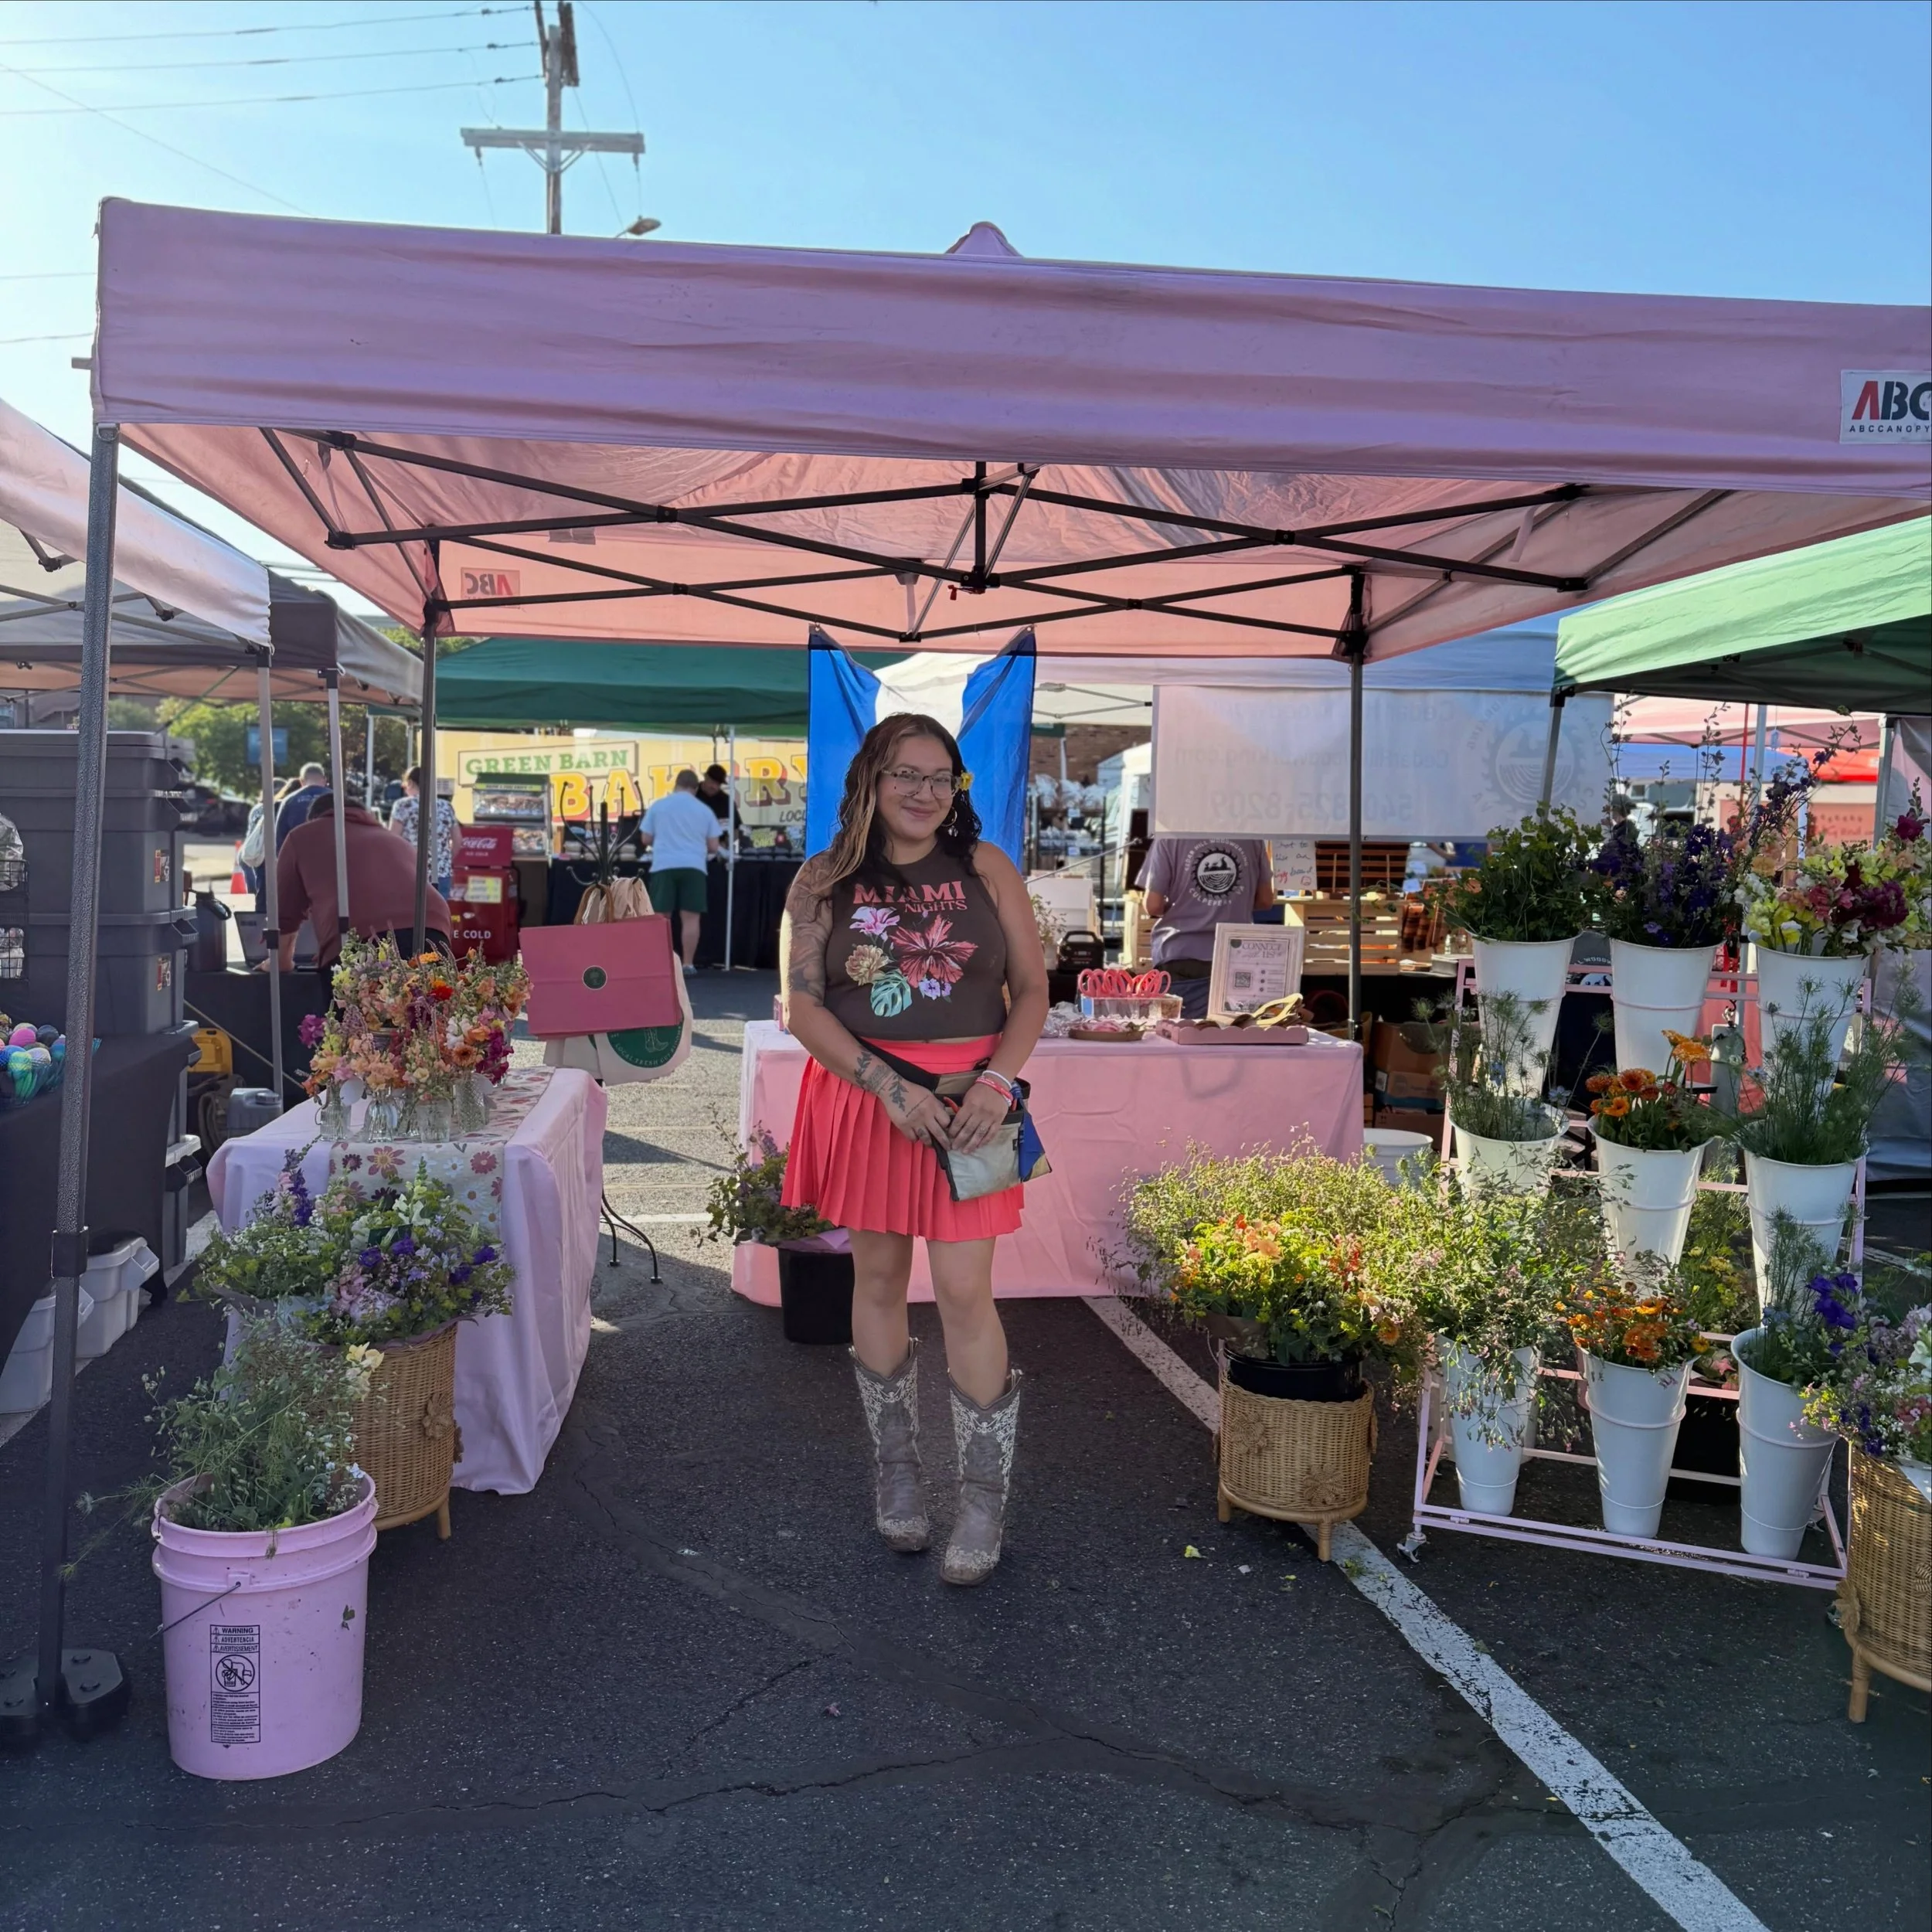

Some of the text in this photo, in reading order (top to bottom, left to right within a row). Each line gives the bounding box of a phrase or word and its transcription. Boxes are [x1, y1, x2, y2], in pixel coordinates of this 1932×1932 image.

[1852, 381, 1931, 420] ABC
[465, 750, 628, 774] GREEN BARN
[550, 754, 806, 821] BAKR
[853, 880, 966, 904] MIAMI
[905, 900, 968, 913] NIGHTS
[464, 930, 492, 939] COLD
[615, 1043, 634, 1061] LOCAL
